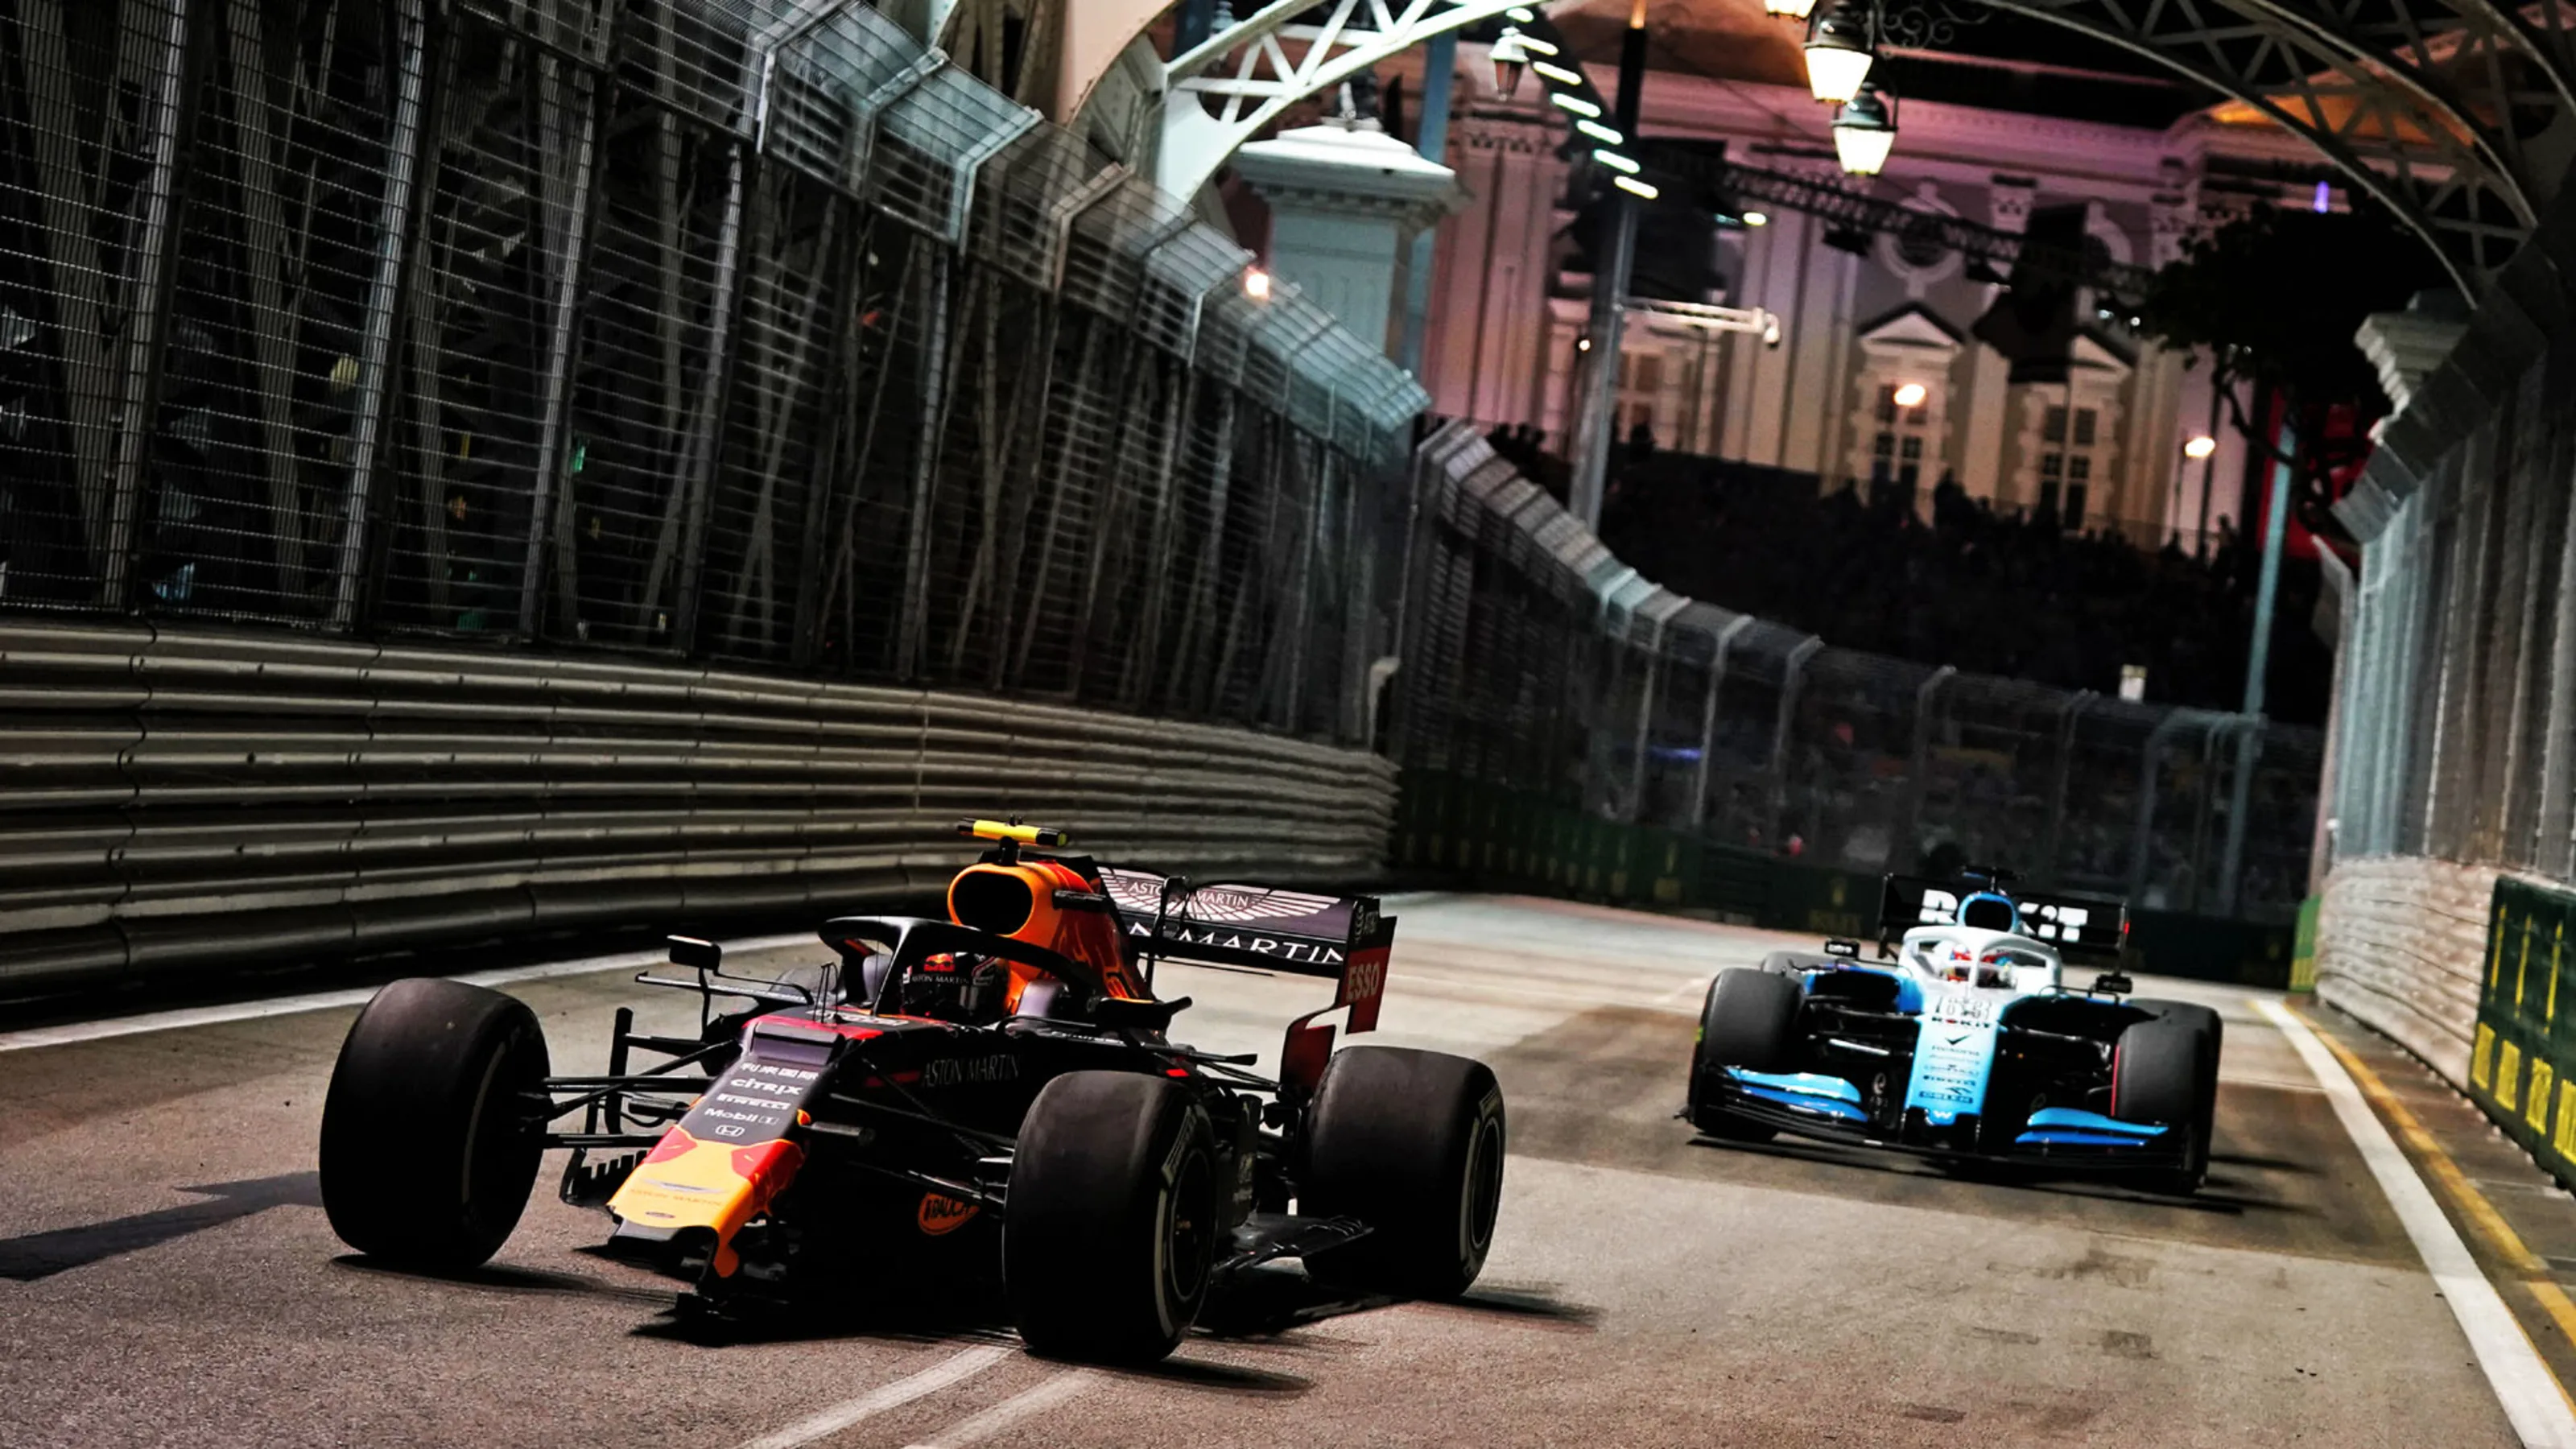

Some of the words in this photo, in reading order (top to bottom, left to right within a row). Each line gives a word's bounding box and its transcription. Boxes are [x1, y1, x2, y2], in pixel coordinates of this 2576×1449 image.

[1196, 890, 1249, 907] MARTIN
[922, 1059, 963, 1088] ASTON
[967, 1054, 1022, 1083] MARTIN
[704, 1108, 759, 1122] Mobil
